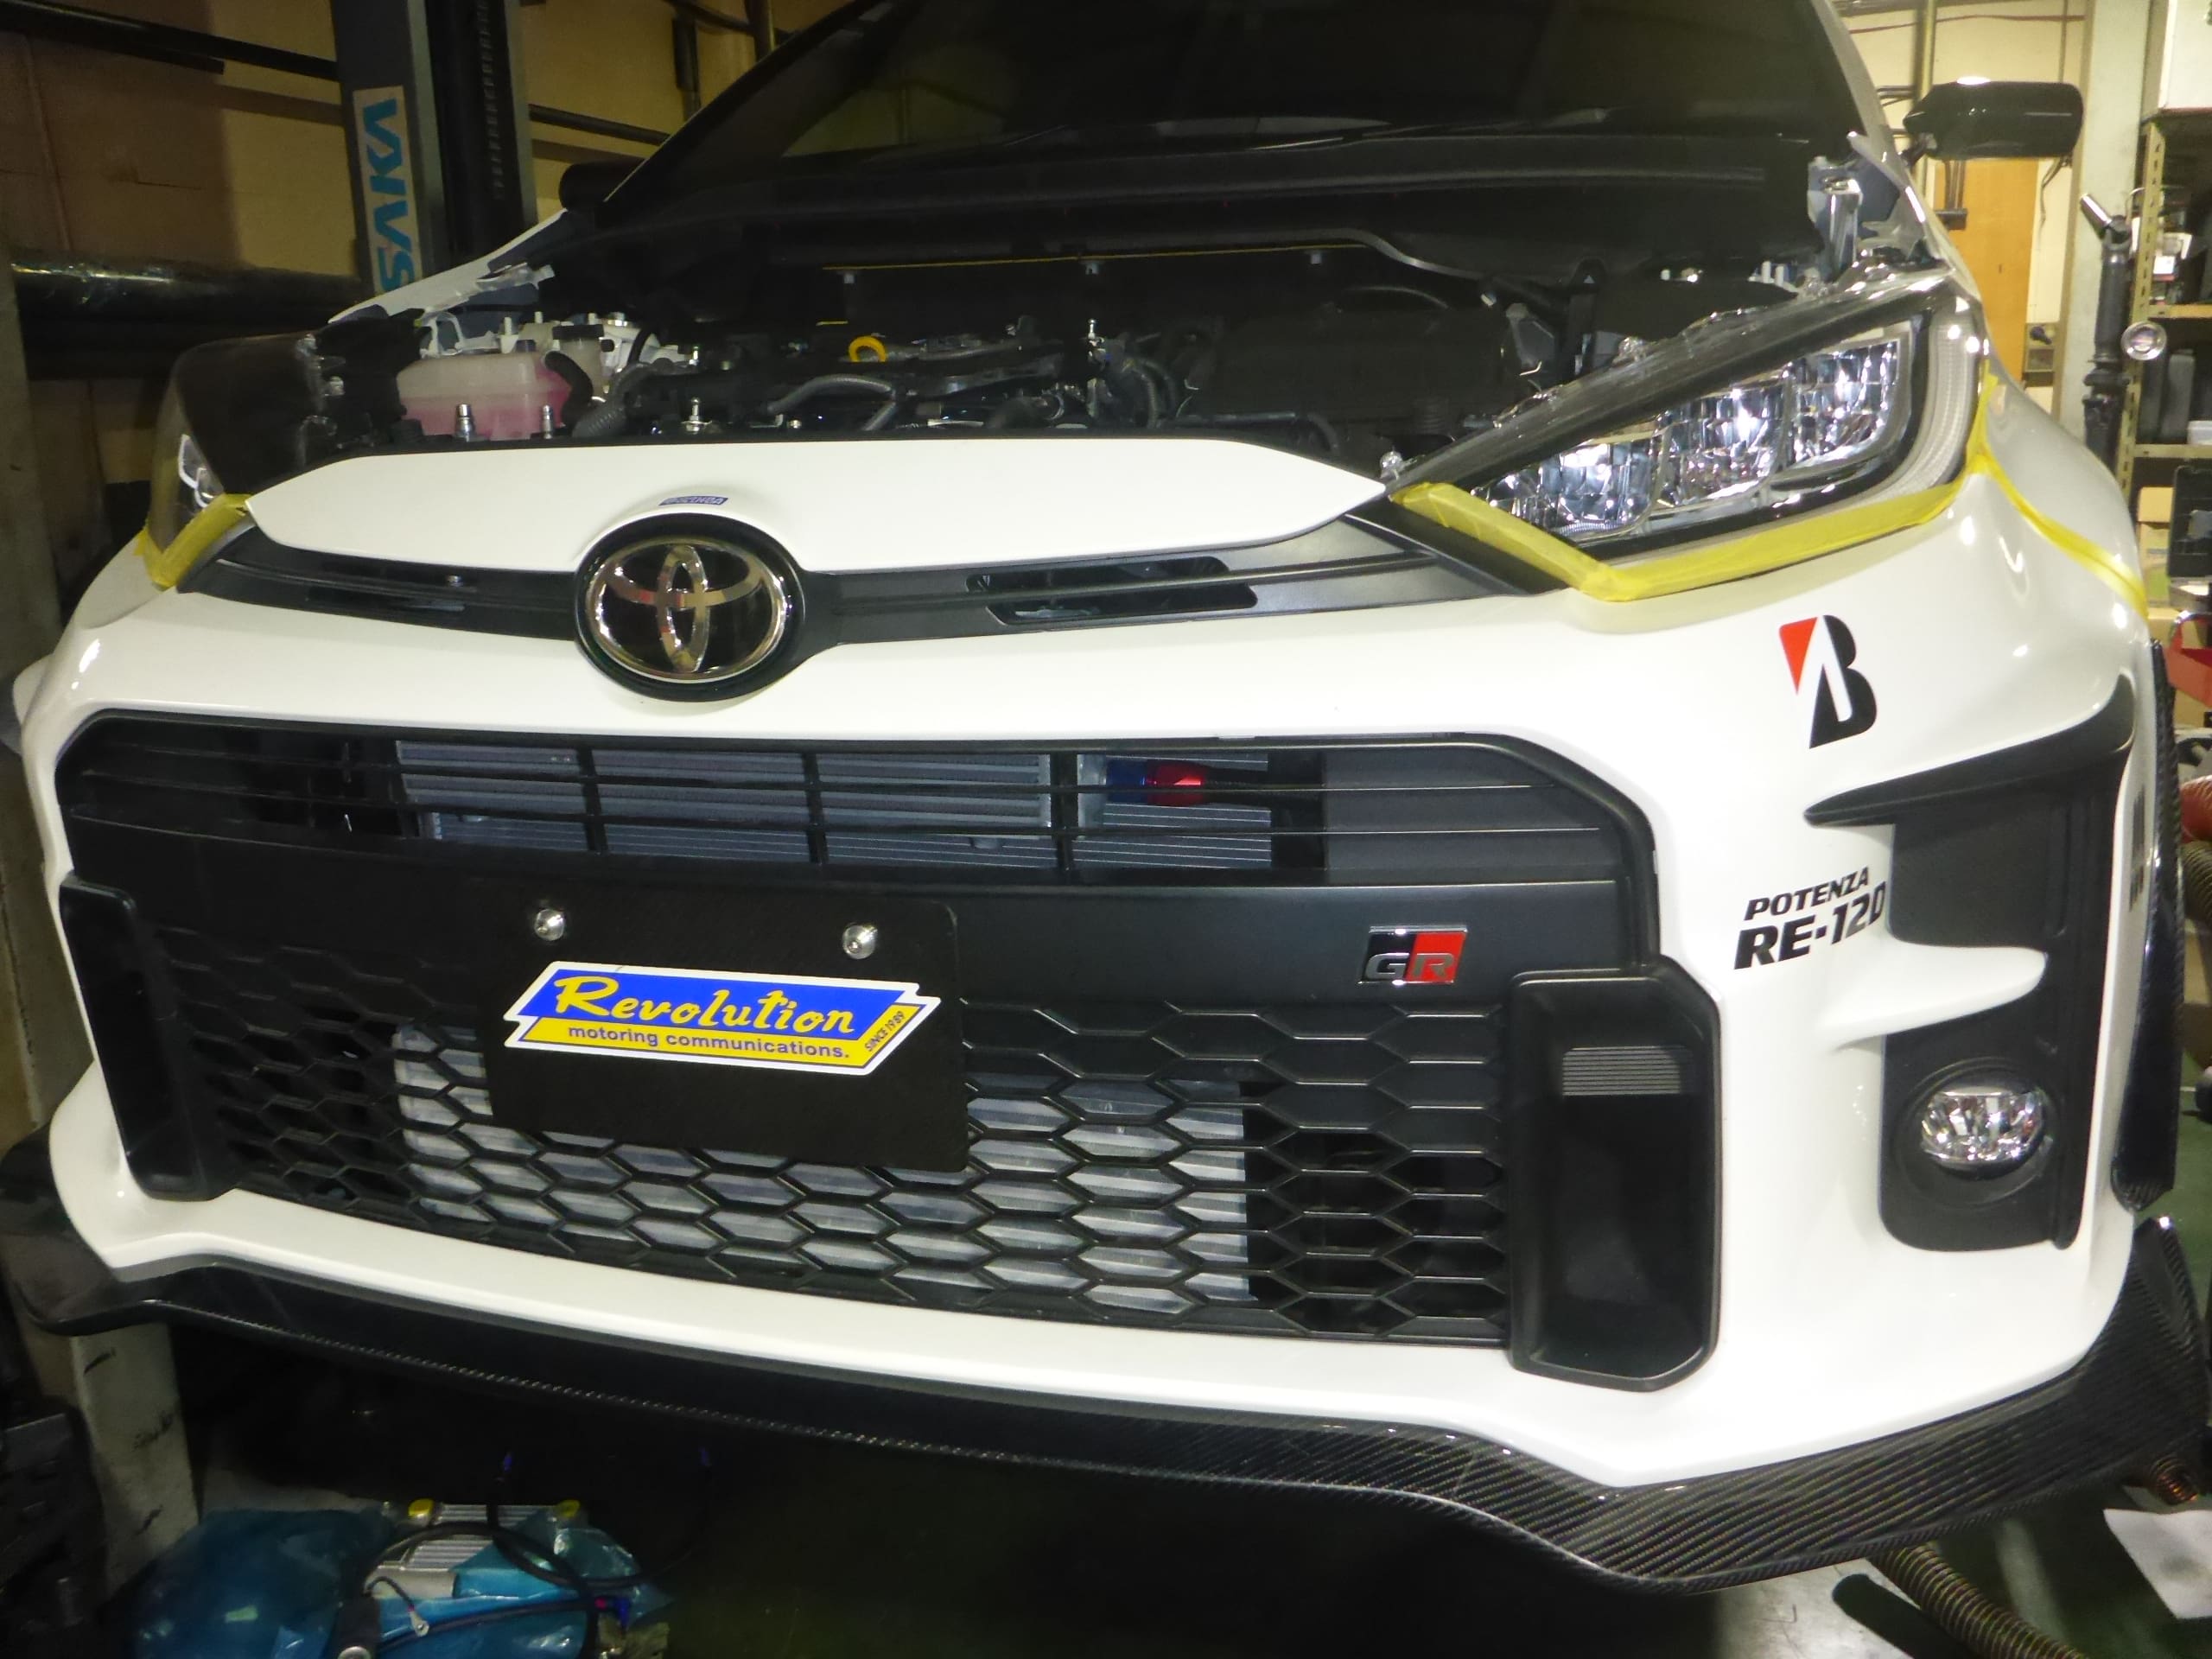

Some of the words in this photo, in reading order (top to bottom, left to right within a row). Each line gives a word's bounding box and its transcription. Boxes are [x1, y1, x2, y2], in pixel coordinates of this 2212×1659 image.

[1744, 867, 1869, 921] POTENZA
[1365, 952, 1455, 980] GR
[554, 976, 855, 1033] Revolution
[569, 1026, 658, 1046] motoring
[665, 1033, 849, 1058] communications.
[864, 1027, 888, 1052] SINCE
[884, 1010, 906, 1032] 1989
